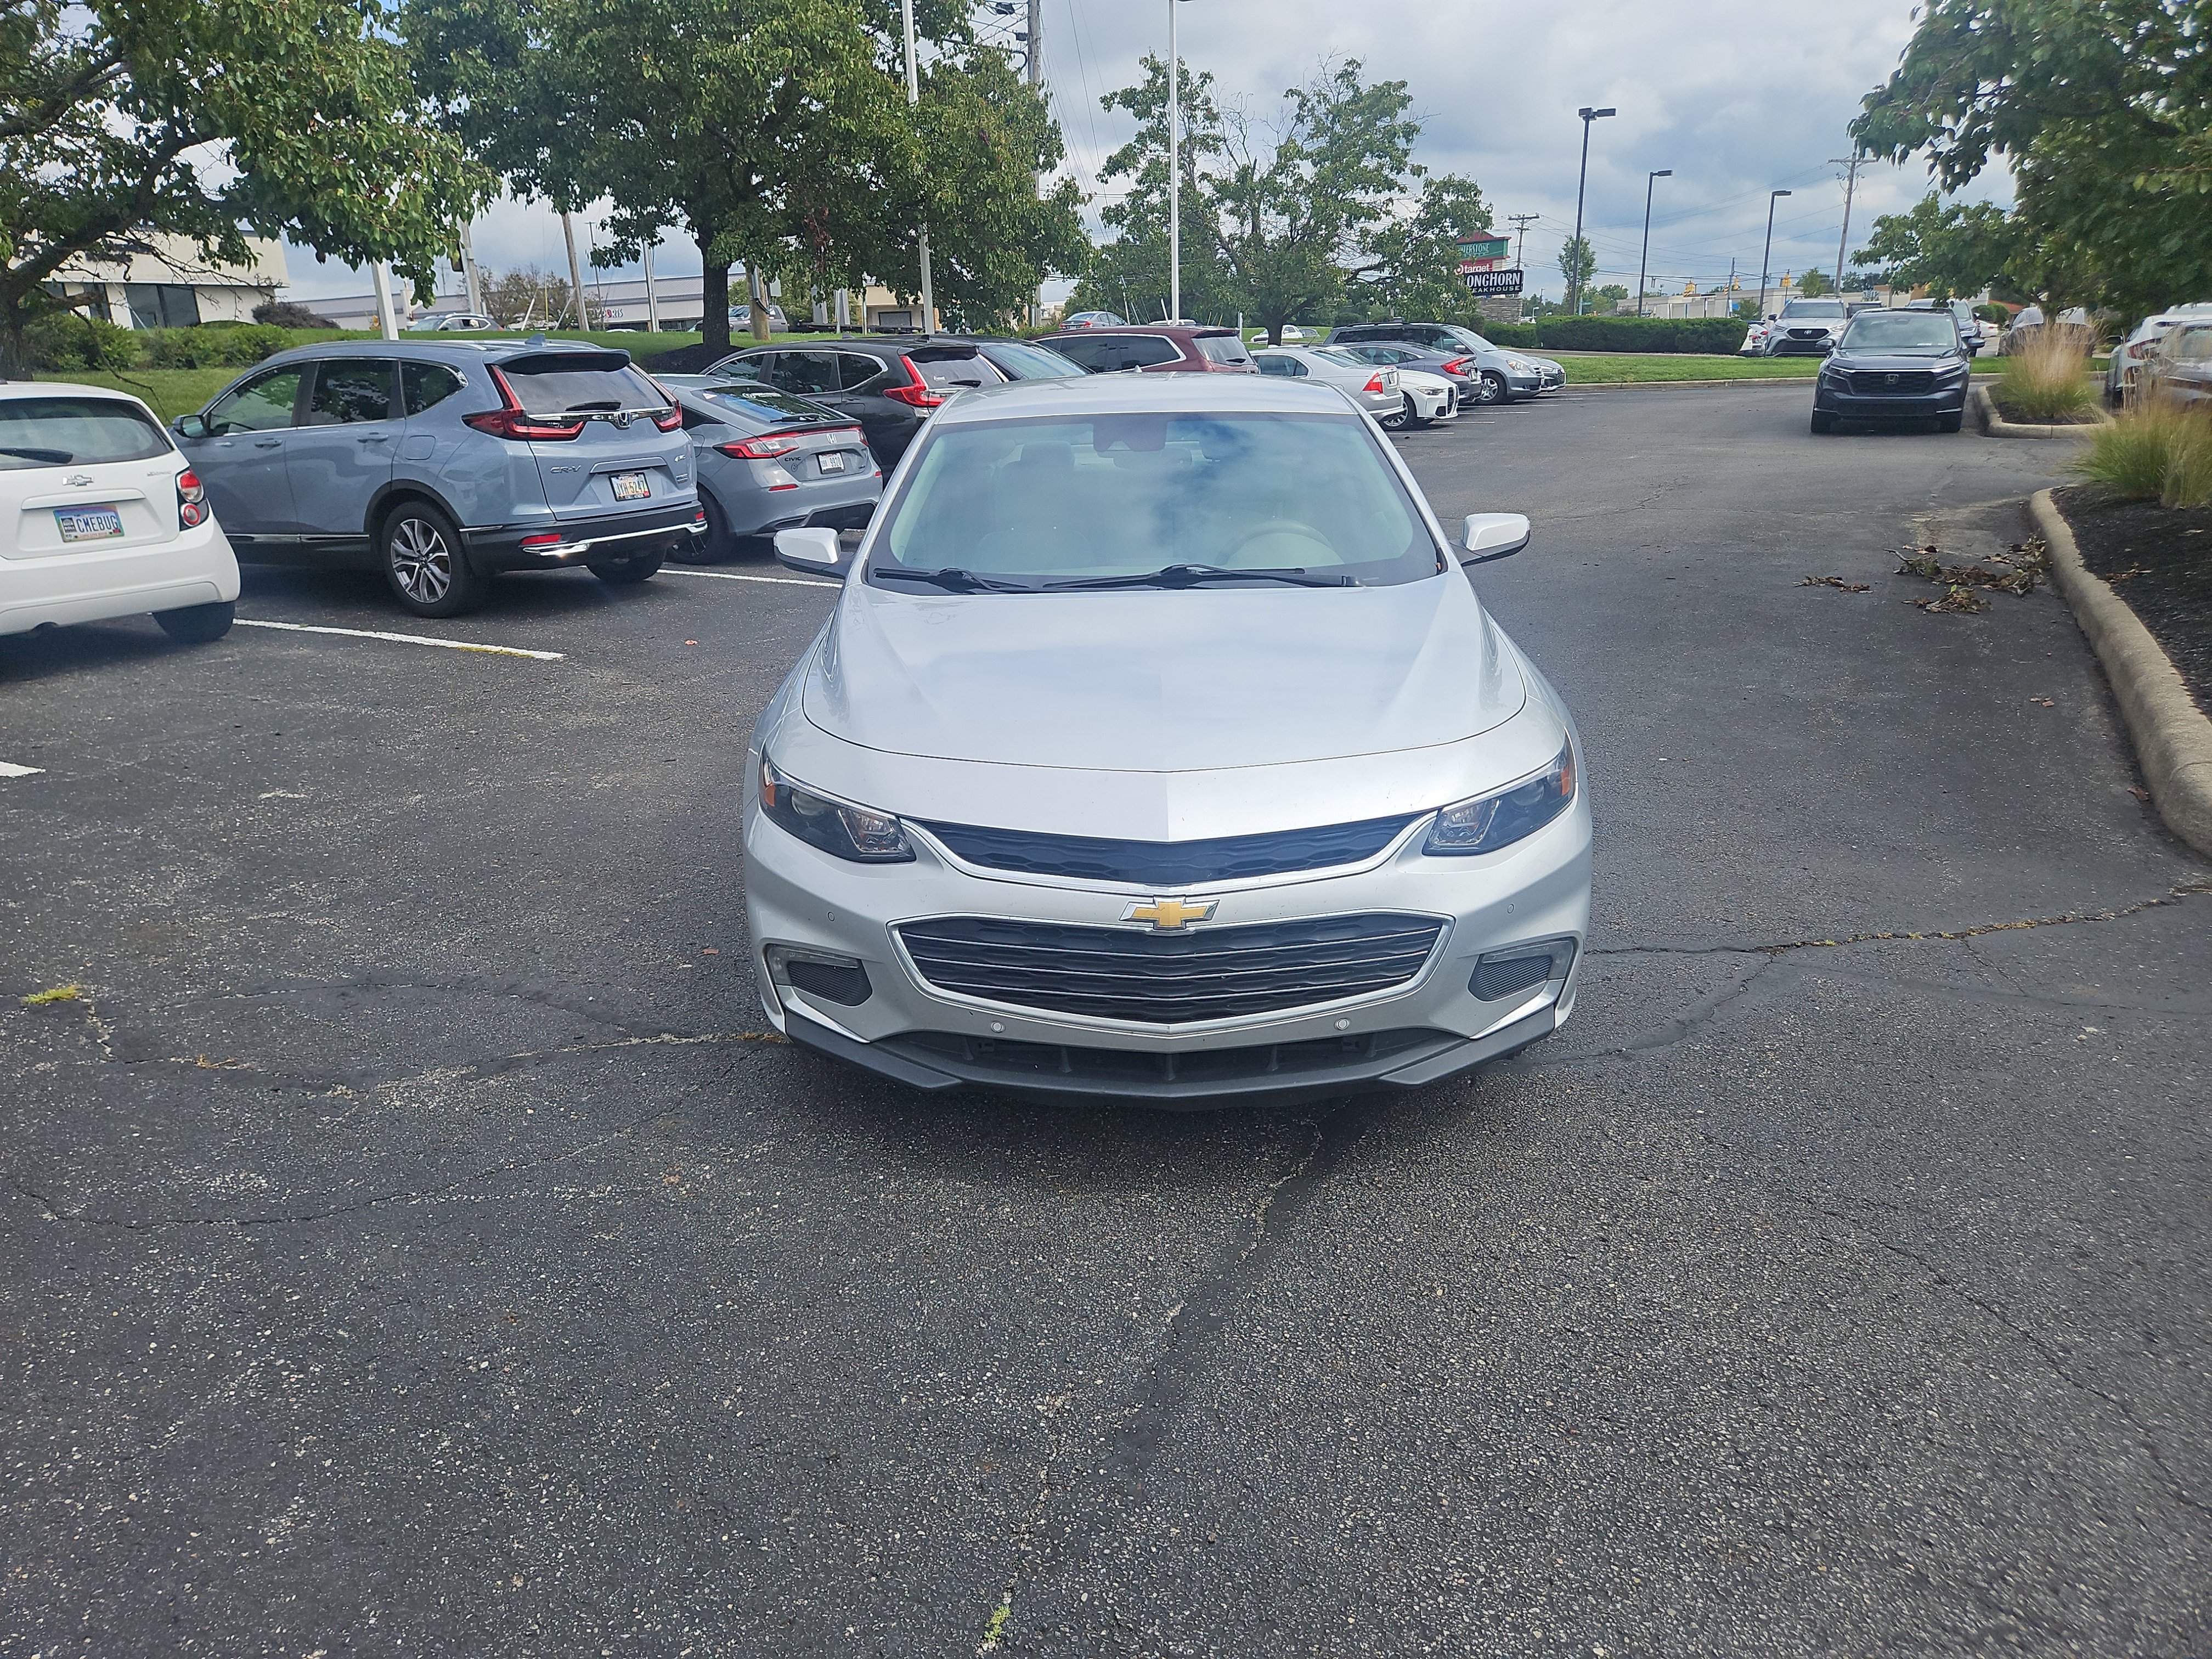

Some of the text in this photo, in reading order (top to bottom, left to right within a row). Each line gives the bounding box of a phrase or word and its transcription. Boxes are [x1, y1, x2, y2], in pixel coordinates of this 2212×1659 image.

[1464, 263, 1490, 273] target
[1466, 273, 1521, 287] ONGHORN
[830, 456, 842, 467] 9920
[550, 465, 582, 473] CR-V
[617, 480, 646, 495] JYH 5247
[76, 515, 119, 533] CMEBUG
